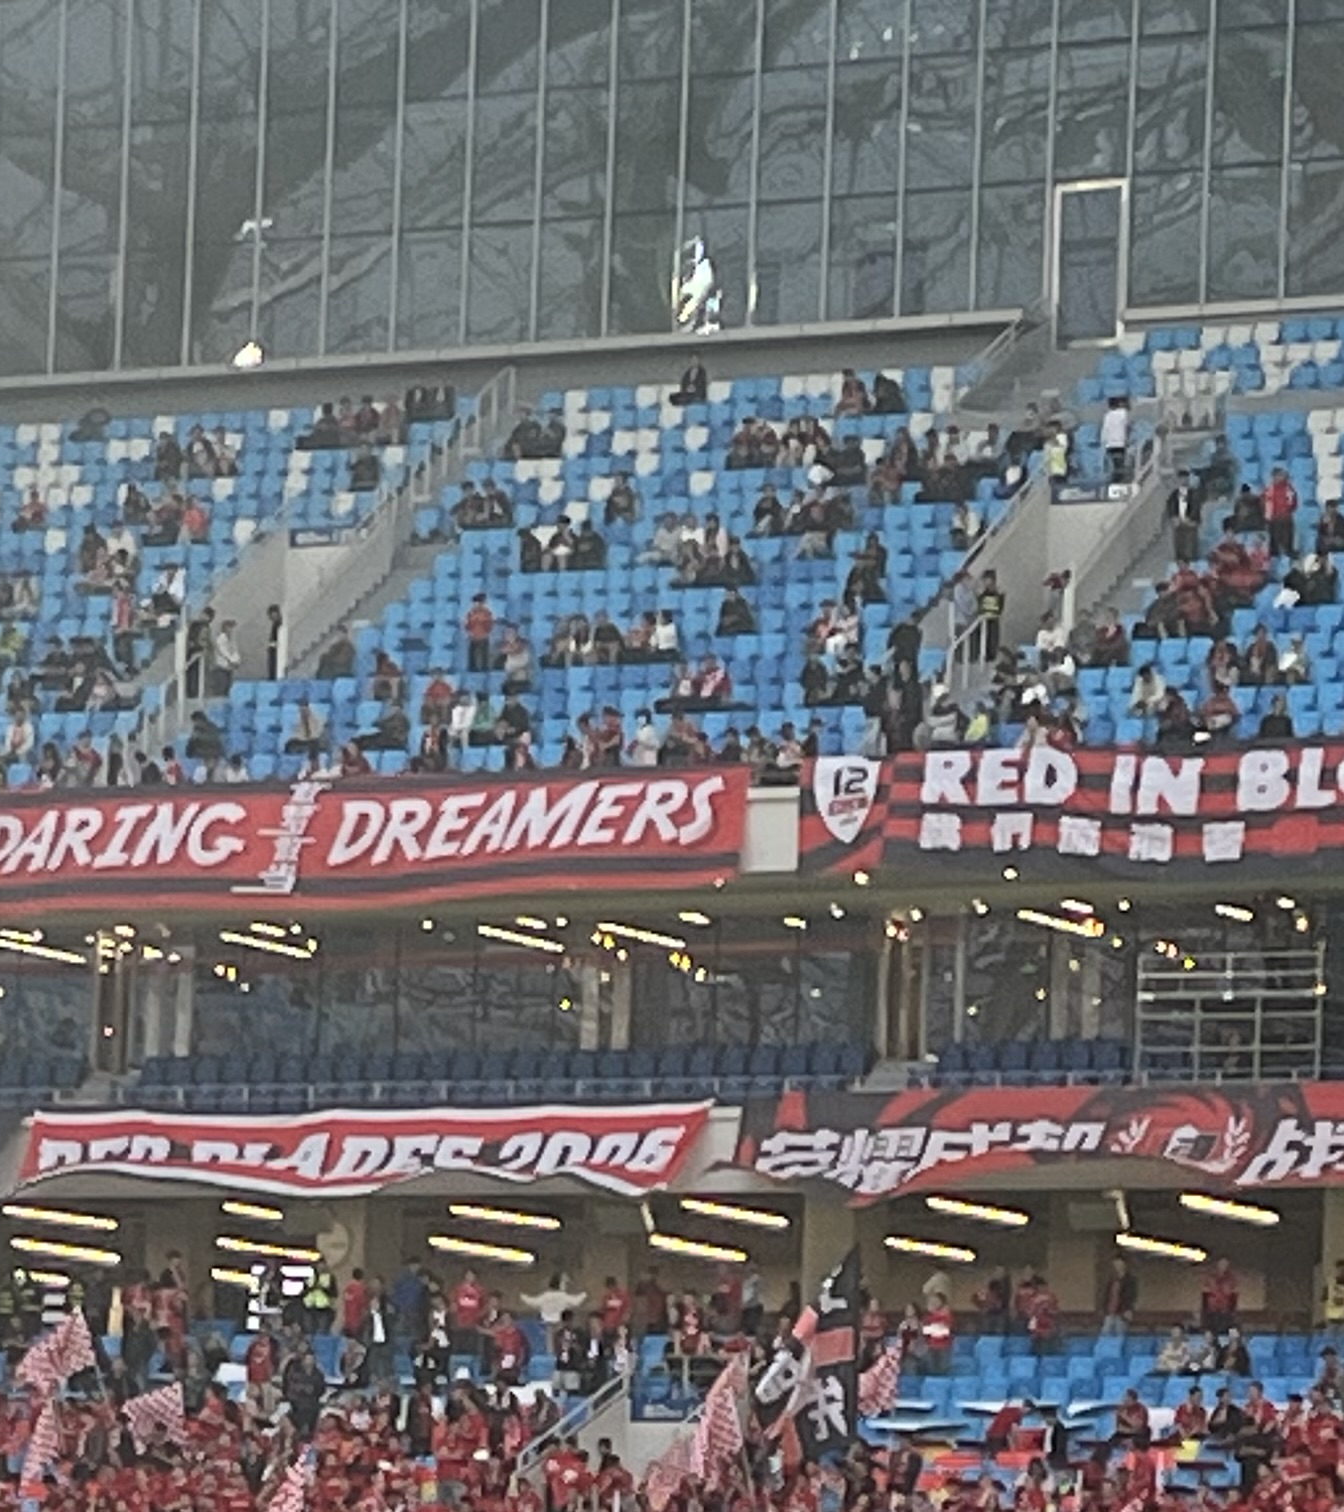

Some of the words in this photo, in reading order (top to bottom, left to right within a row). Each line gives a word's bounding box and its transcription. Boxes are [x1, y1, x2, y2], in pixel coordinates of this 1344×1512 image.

[833, 766, 869, 796] 12
[920, 748, 1078, 805] RED
[1110, 754, 1205, 815] IN
[328, 775, 725, 868] DREAMERS
